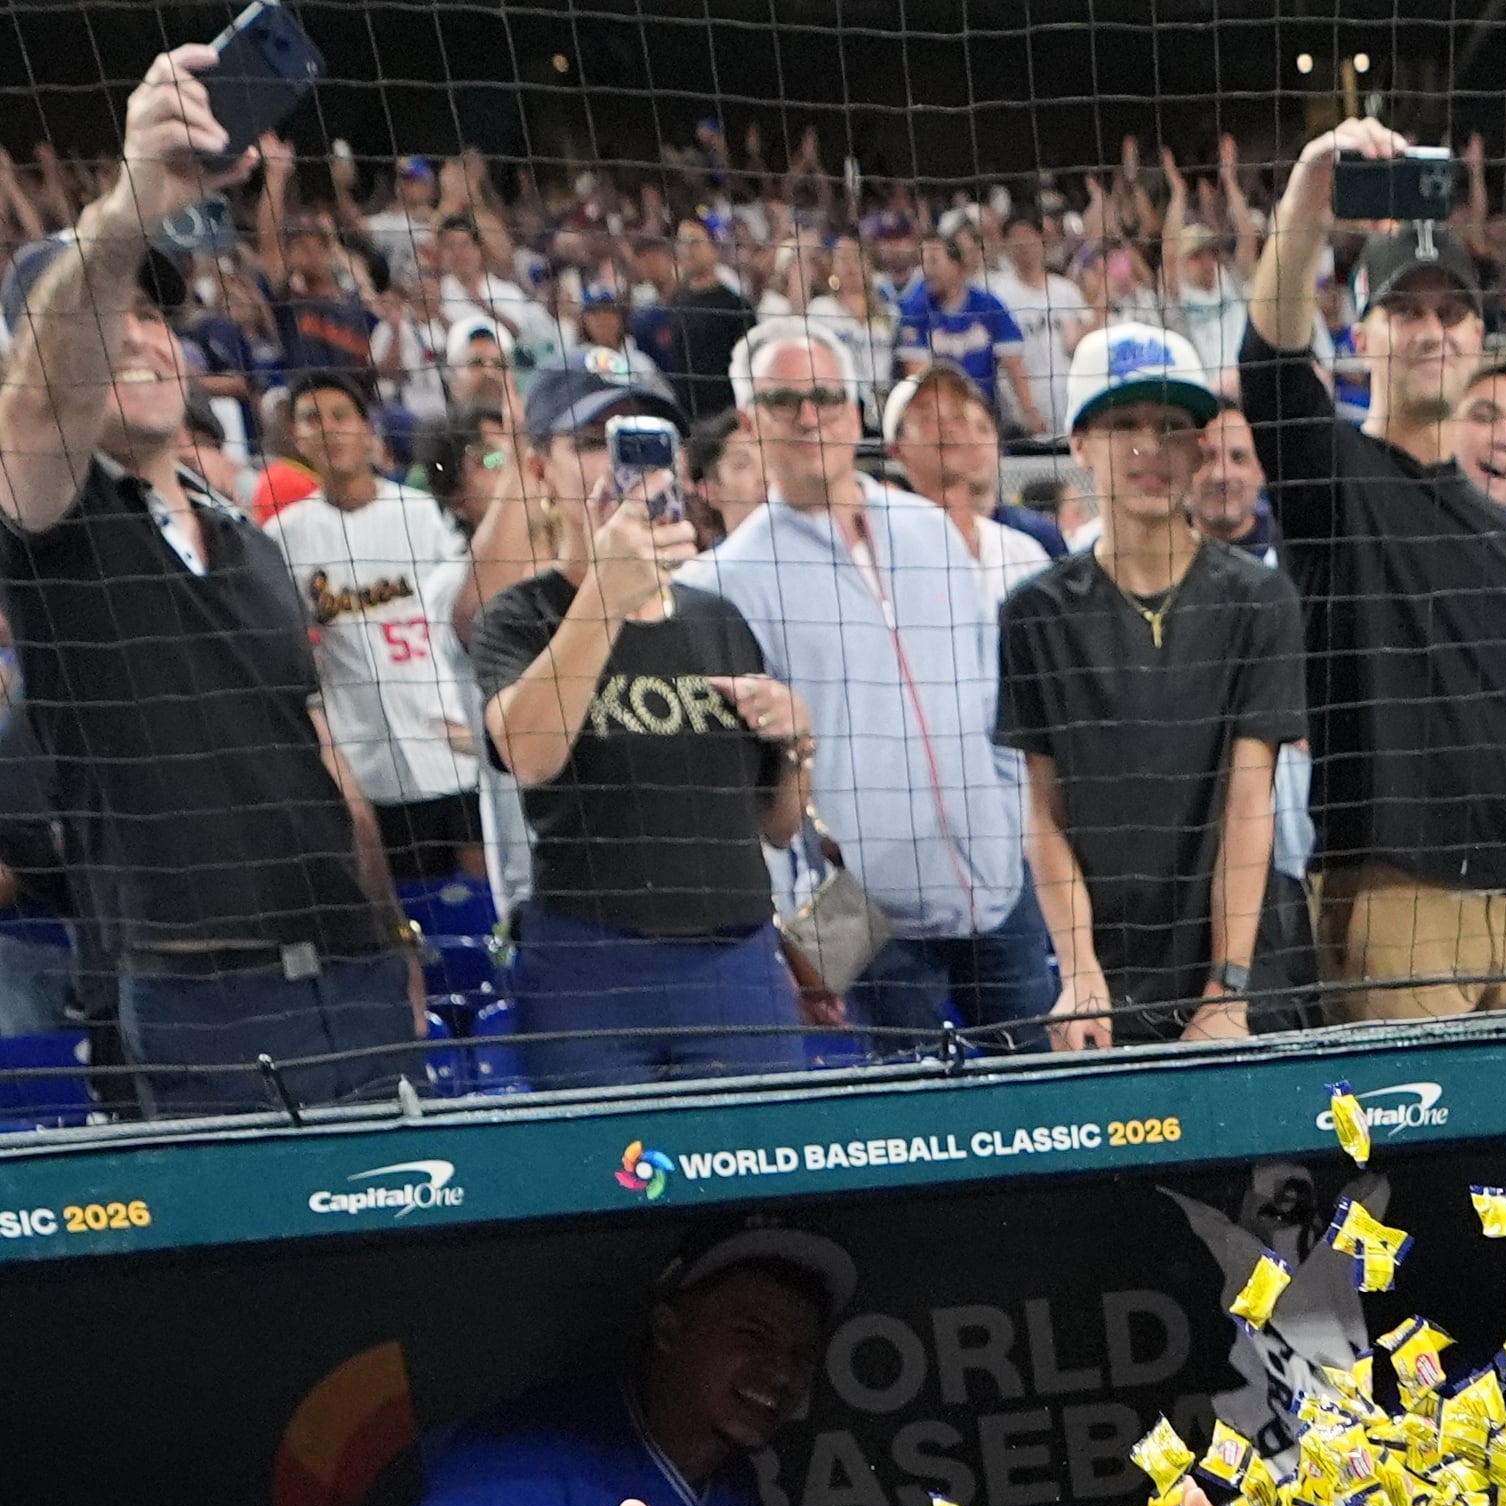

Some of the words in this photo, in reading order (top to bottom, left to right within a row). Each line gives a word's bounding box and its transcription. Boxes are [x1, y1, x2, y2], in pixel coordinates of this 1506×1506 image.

[679, 1147, 800, 1180] WORLD
[804, 1133, 967, 1171] BASEBALL
[970, 1122, 1103, 1157] CLASSIC
[1107, 1117, 1182, 1147] 2026
[62, 1200, 153, 1234] 2026
[798, 1289, 1191, 1416] ORLD
